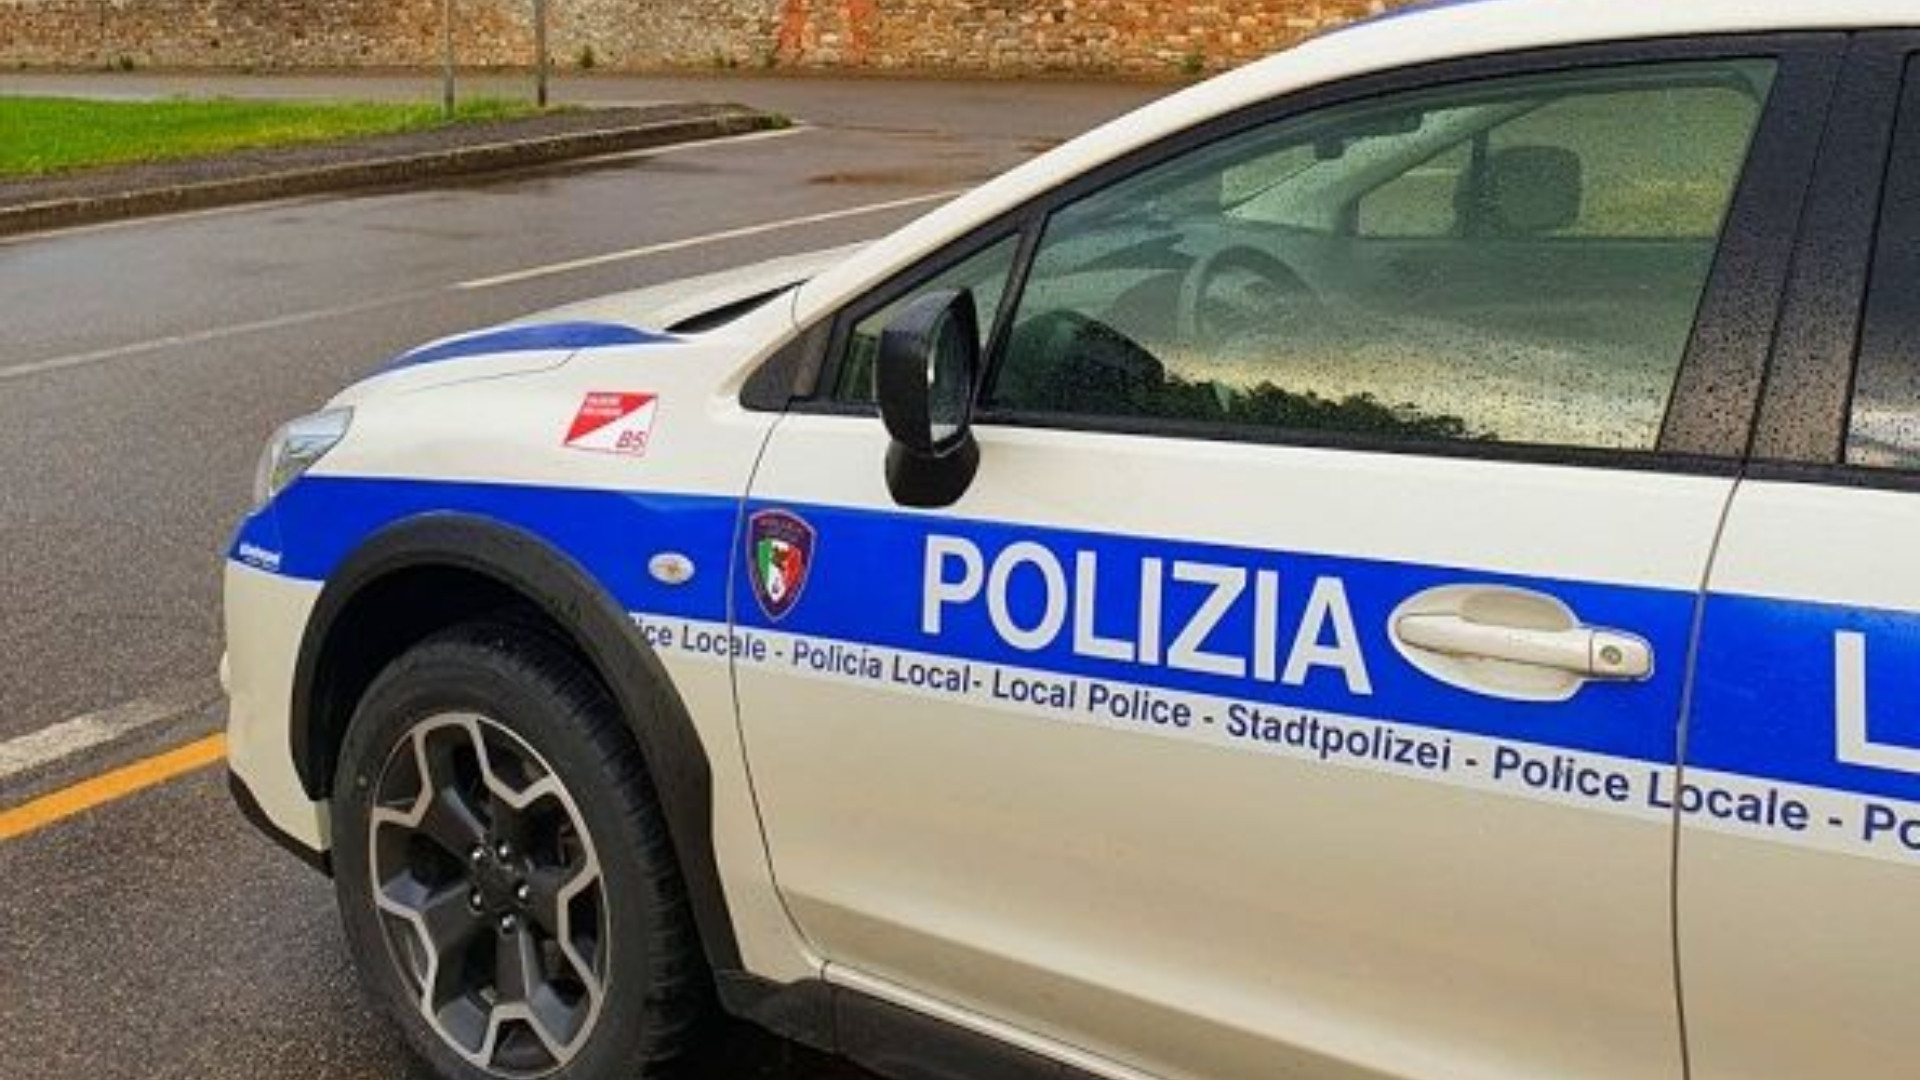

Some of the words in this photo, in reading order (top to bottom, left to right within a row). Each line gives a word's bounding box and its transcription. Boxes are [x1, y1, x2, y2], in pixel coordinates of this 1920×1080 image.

[637, 617, 672, 647] ice
[681, 625, 767, 661] Locale
[792, 639, 882, 679] Policia
[991, 669, 1077, 709] Local
[1088, 683, 1192, 728] Police
[1226, 703, 1453, 771] Stadtpolizei
[1493, 745, 1630, 801] Police
[1647, 770, 1809, 831] Locale
[921, 533, 1373, 695] POLIZIA
[1835, 631, 1920, 773] L
